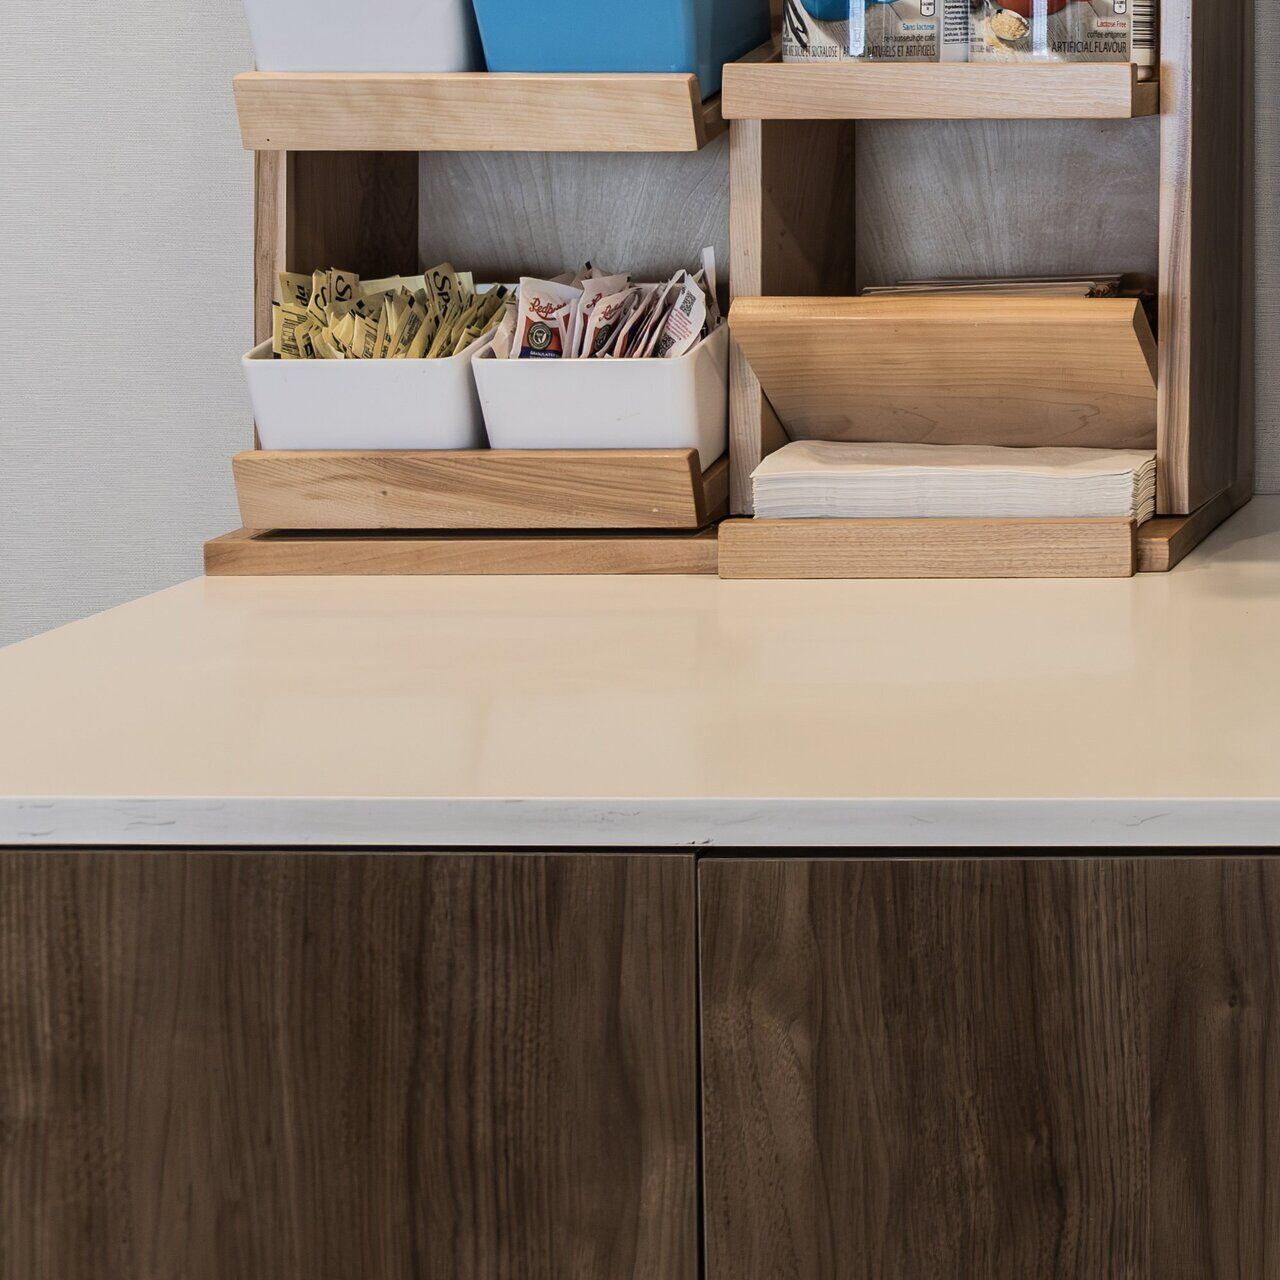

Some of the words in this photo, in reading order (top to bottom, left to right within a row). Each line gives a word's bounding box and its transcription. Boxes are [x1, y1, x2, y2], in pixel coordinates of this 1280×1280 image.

[897, 45, 904, 57] ET
[1051, 41, 1094, 54] ARTIFICIAL
[1094, 41, 1127, 54] FLAVOUR
